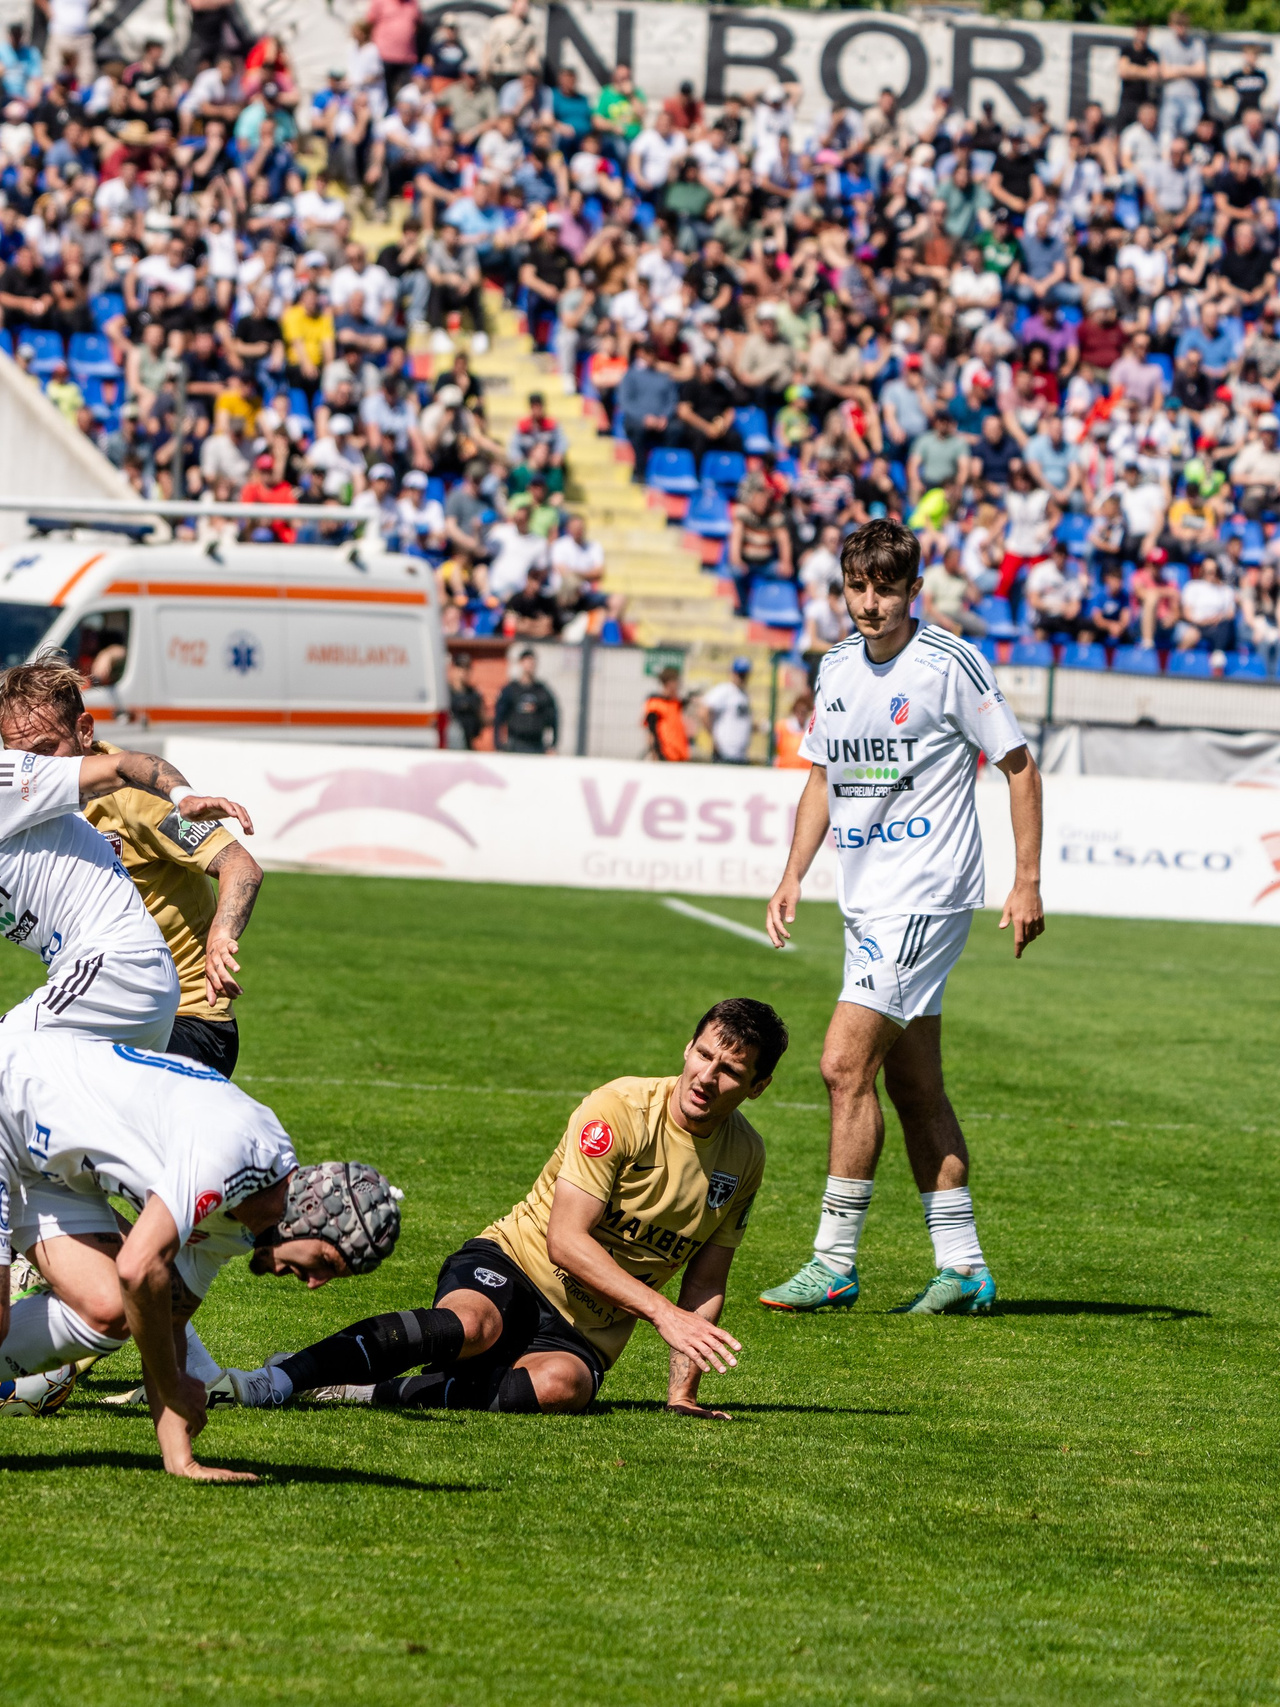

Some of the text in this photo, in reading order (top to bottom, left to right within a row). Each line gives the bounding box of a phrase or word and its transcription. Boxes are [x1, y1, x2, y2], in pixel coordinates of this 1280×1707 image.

[827, 737, 919, 763] UNIBET
[579, 777, 838, 851] Vest
[582, 849, 836, 891] Grupul Elso
[1060, 844, 1232, 873] ELSACO
[603, 1200, 703, 1266] MAXBET
[552, 1267, 604, 1318] METROPOLA
